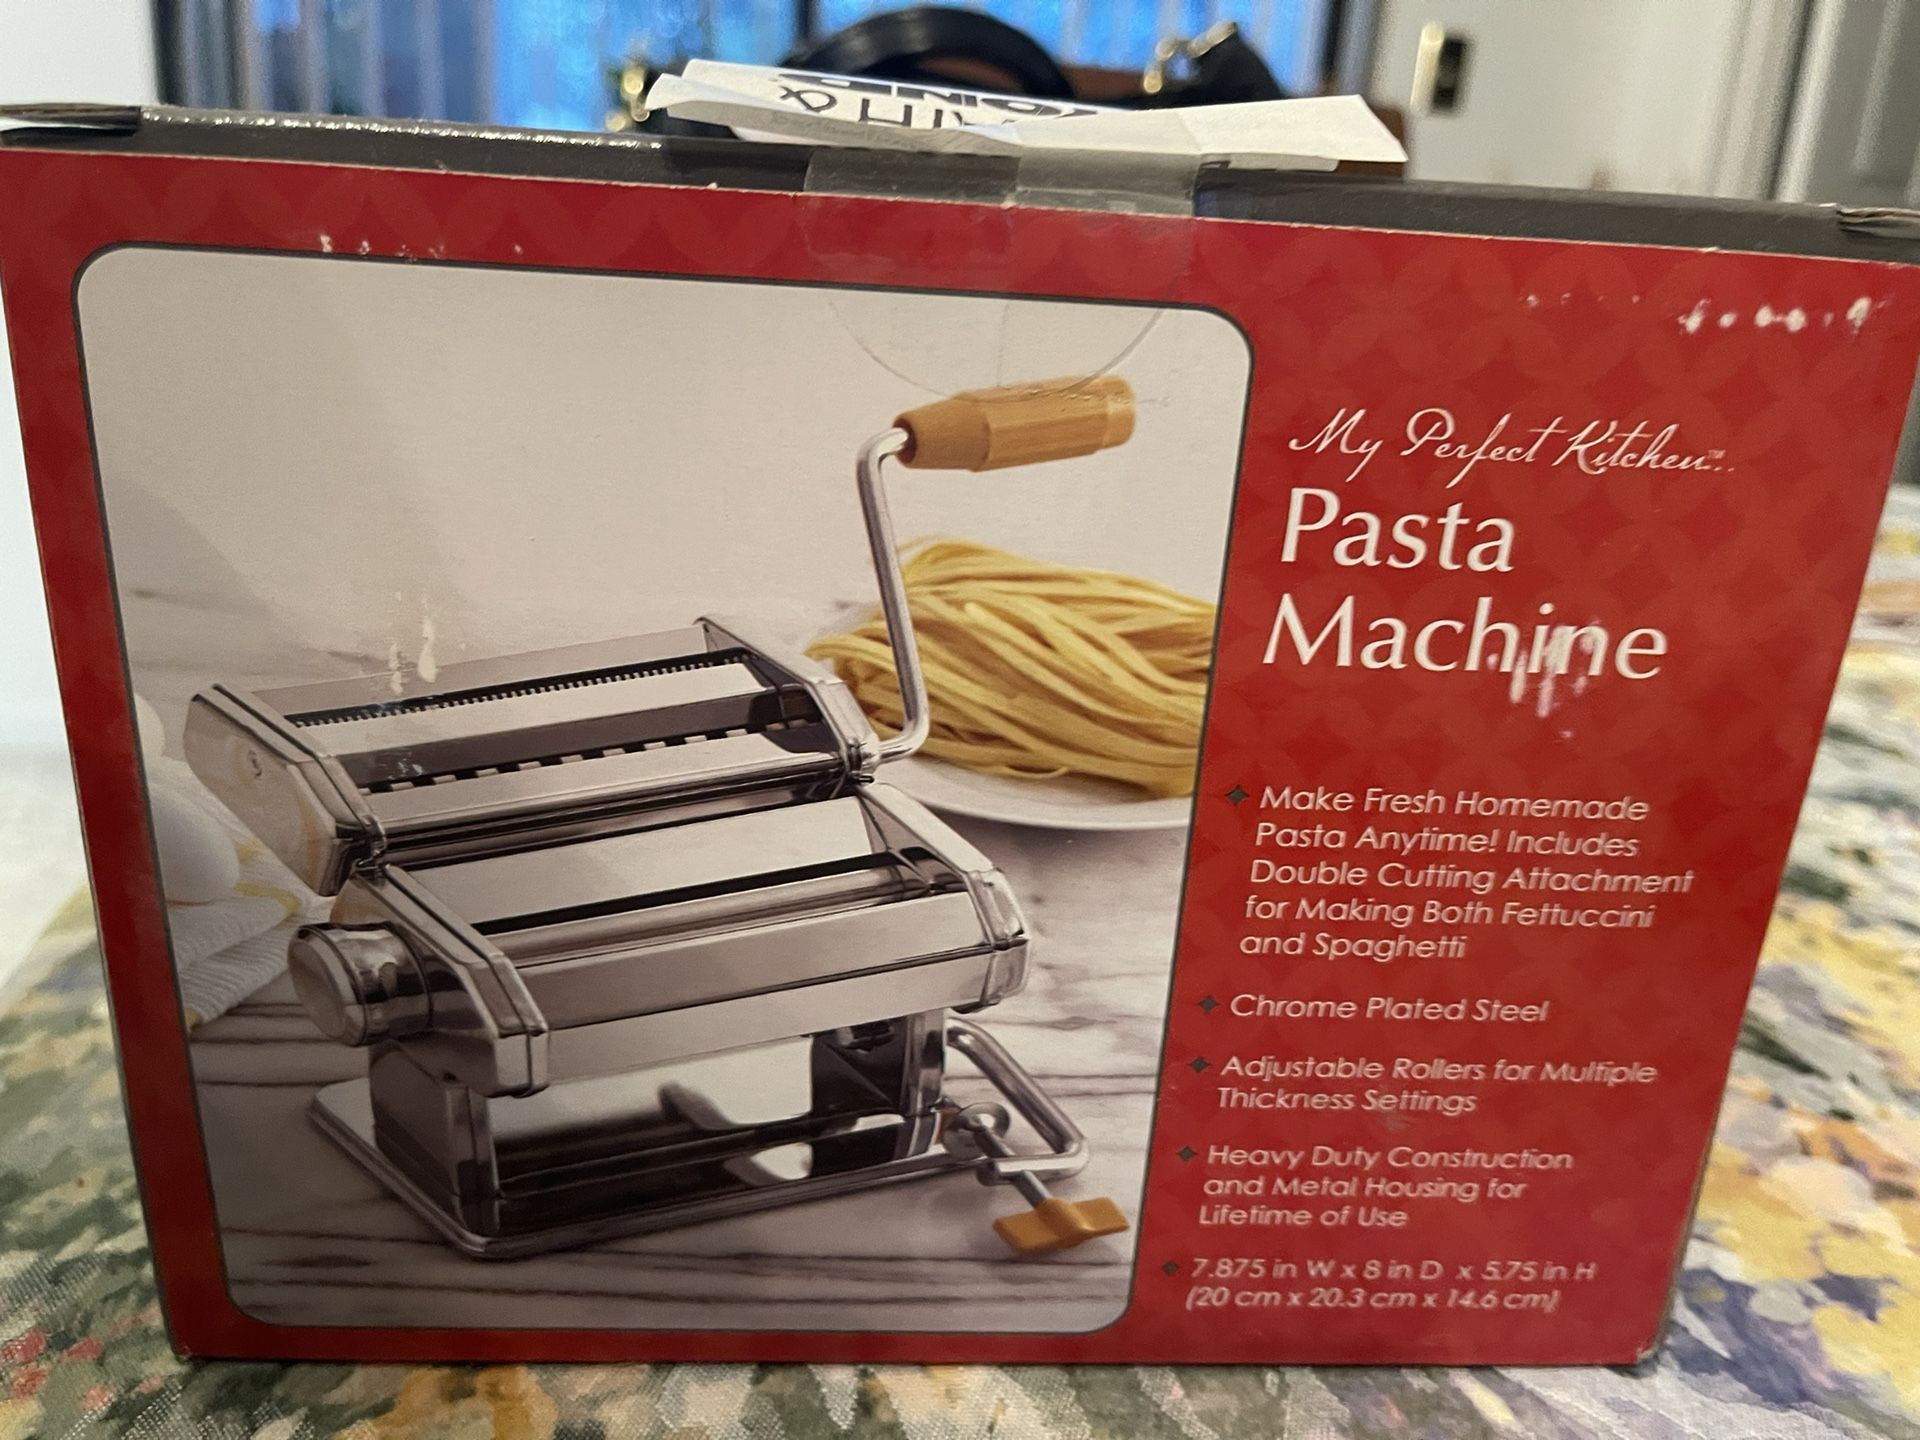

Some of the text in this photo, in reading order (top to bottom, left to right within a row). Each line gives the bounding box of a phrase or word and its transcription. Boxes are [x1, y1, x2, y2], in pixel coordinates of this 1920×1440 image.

[1288, 408, 1383, 482] My
[1400, 408, 1567, 488] Perfect
[1281, 487, 1515, 573] Pasta
[1263, 592, 1668, 680] Machine
[1260, 786, 1649, 820] Make Fresh Homemade
[1256, 822, 1640, 856] Pasta Anytime! Includes
[1251, 860, 1694, 894] Double Cutting Attachment
[1246, 895, 1655, 928] for Making Both Fettuccini
[1240, 932, 1467, 962] and Spaghetti
[1231, 994, 1549, 1022] Chrome Plated Steel
[1221, 1056, 1658, 1086] Adjustable Rollers for Multiple
[1218, 1087, 1477, 1116] Thickness Settings
[1208, 1145, 1573, 1170] Heavy Duty Construction
[1204, 1176, 1528, 1203] and Metal Housing for
[1199, 1204, 1409, 1227] Lifetime of Use
[1192, 1258, 1266, 1278] 7.875
[1273, 1259, 1297, 1278] in
[1307, 1260, 1335, 1277] W
[1340, 1265, 1356, 1278] x
[1363, 1260, 1381, 1280] 8
[1387, 1260, 1413, 1279] in
[1420, 1260, 1443, 1280] D
[1456, 1266, 1472, 1279] x
[1542, 1261, 1568, 1280] in
[1574, 1262, 1597, 1280] H
[1235, 1291, 1282, 1307] cm
[1286, 1292, 1303, 1306] x
[1308, 1287, 1366, 1308] 20.3
[1370, 1292, 1416, 1308] cm
[1422, 1293, 1438, 1307] x
